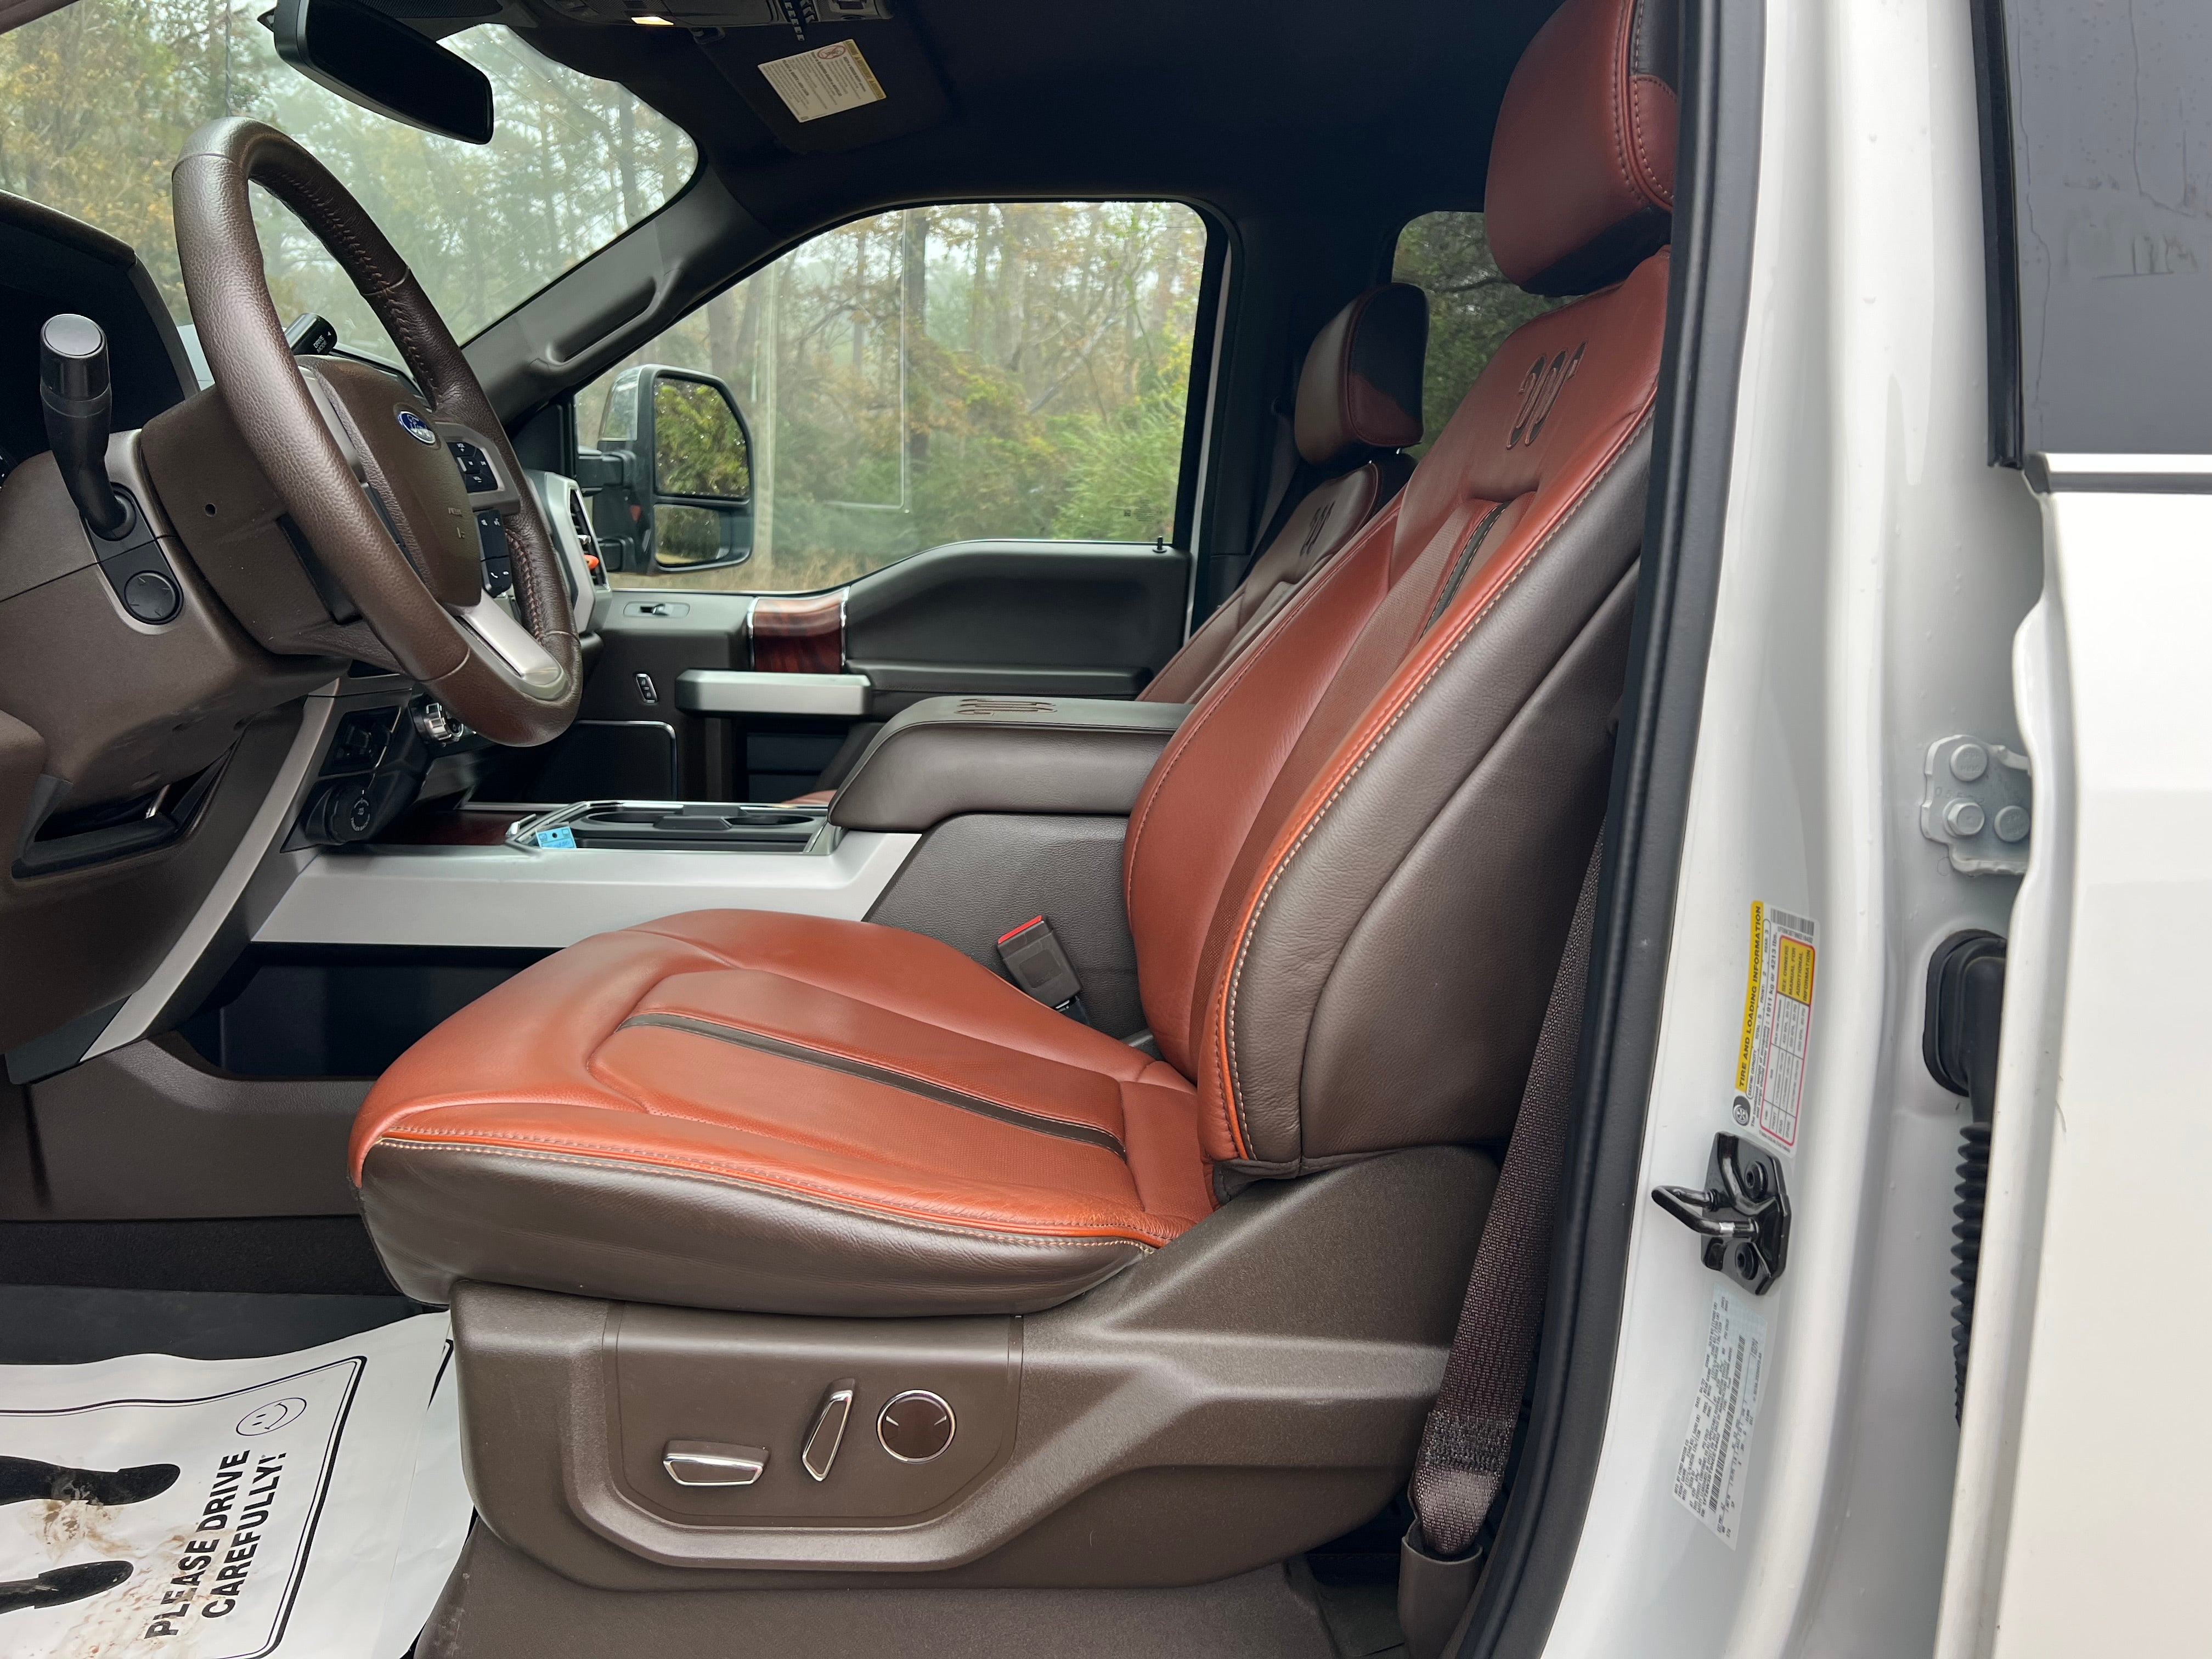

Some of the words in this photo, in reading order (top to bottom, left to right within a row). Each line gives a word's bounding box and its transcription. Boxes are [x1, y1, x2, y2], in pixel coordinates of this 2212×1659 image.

[313, 335, 325, 348] DRIVE
[1746, 985, 1757, 1034] LOADING
[1752, 905, 1760, 982] INFORMATION
[1769, 983, 1774, 995] kg
[1770, 972, 1774, 981] or
[1802, 949, 1810, 1001] INFORMATION
[144, 1539, 218, 1640] PLEASE
[196, 1449, 251, 1534] DRIVE
[201, 1452, 287, 1619] CAREFULLY!
